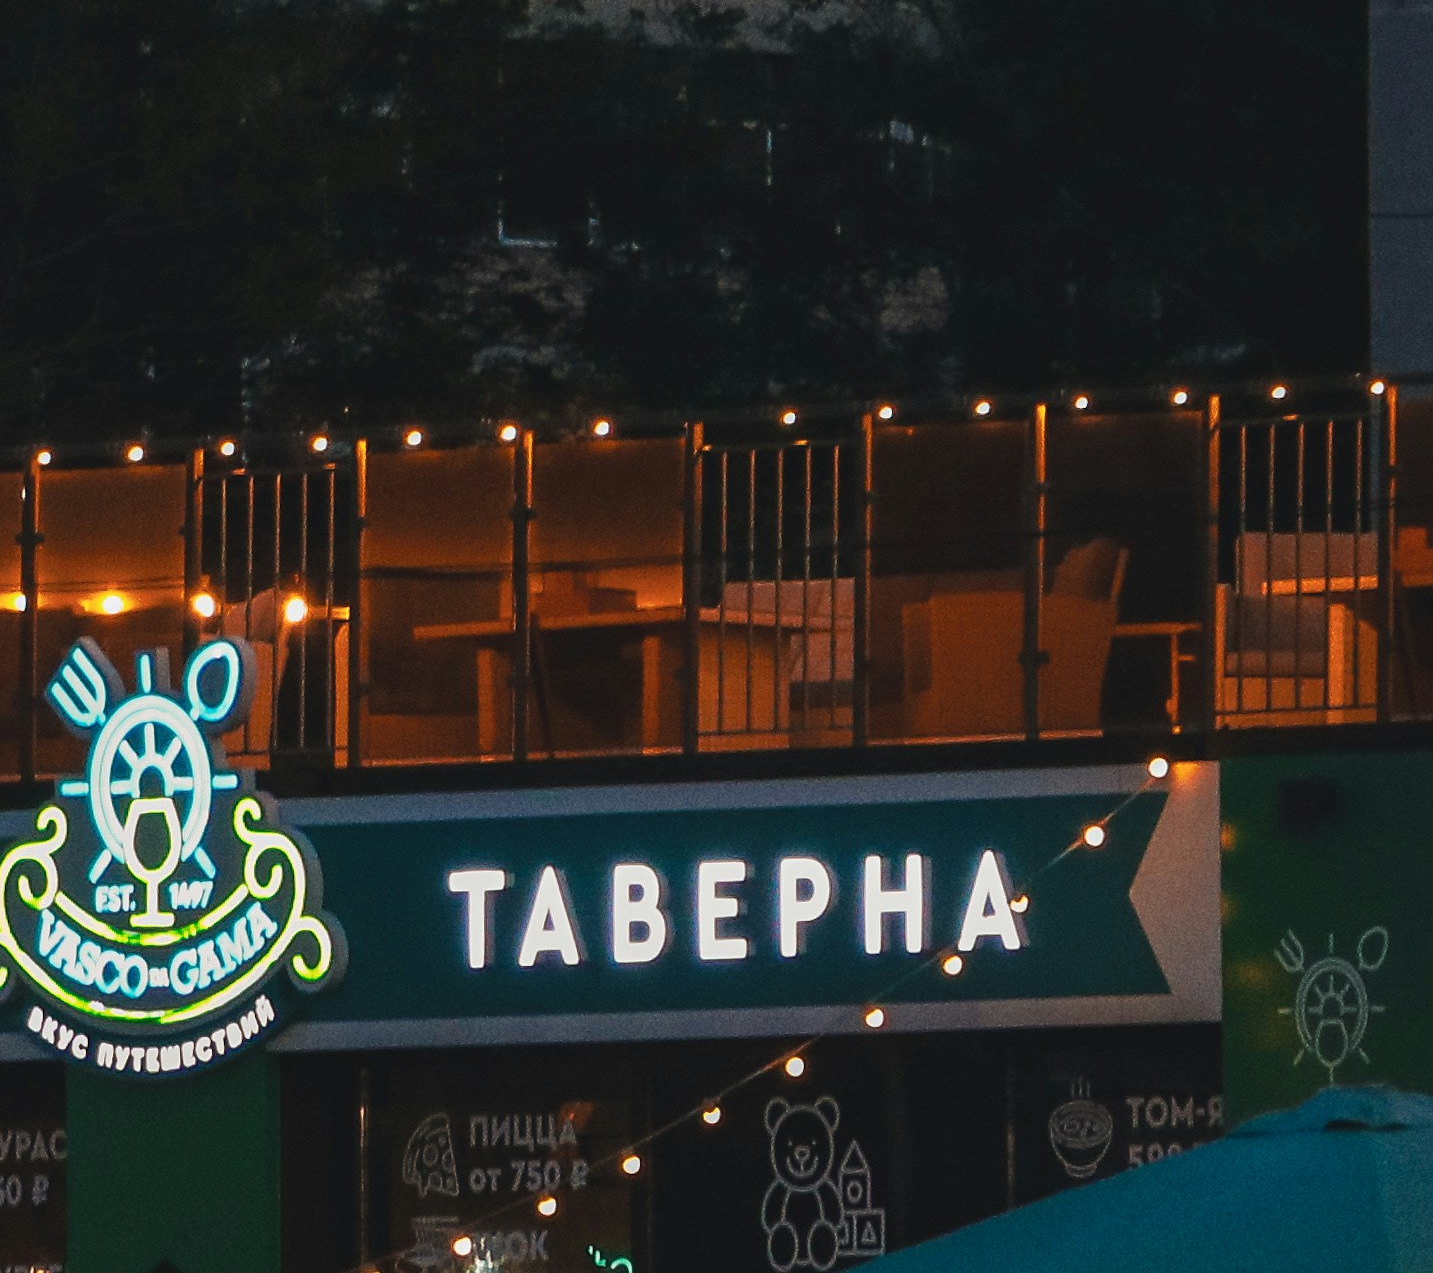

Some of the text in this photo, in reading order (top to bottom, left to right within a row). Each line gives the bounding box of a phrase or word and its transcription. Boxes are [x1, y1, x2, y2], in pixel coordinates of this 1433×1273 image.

[96, 884, 136, 913] EST.
[447, 849, 1023, 970] ТАВЕРНА
[36, 908, 150, 999] VASCO
[169, 901, 278, 995] GAMA
[27, 994, 276, 1073] ВКУС ПУТЕШЕСТВИЙ
[469, 1114, 578, 1151] ПИЦЦА
[511, 1160, 561, 1192] 750
